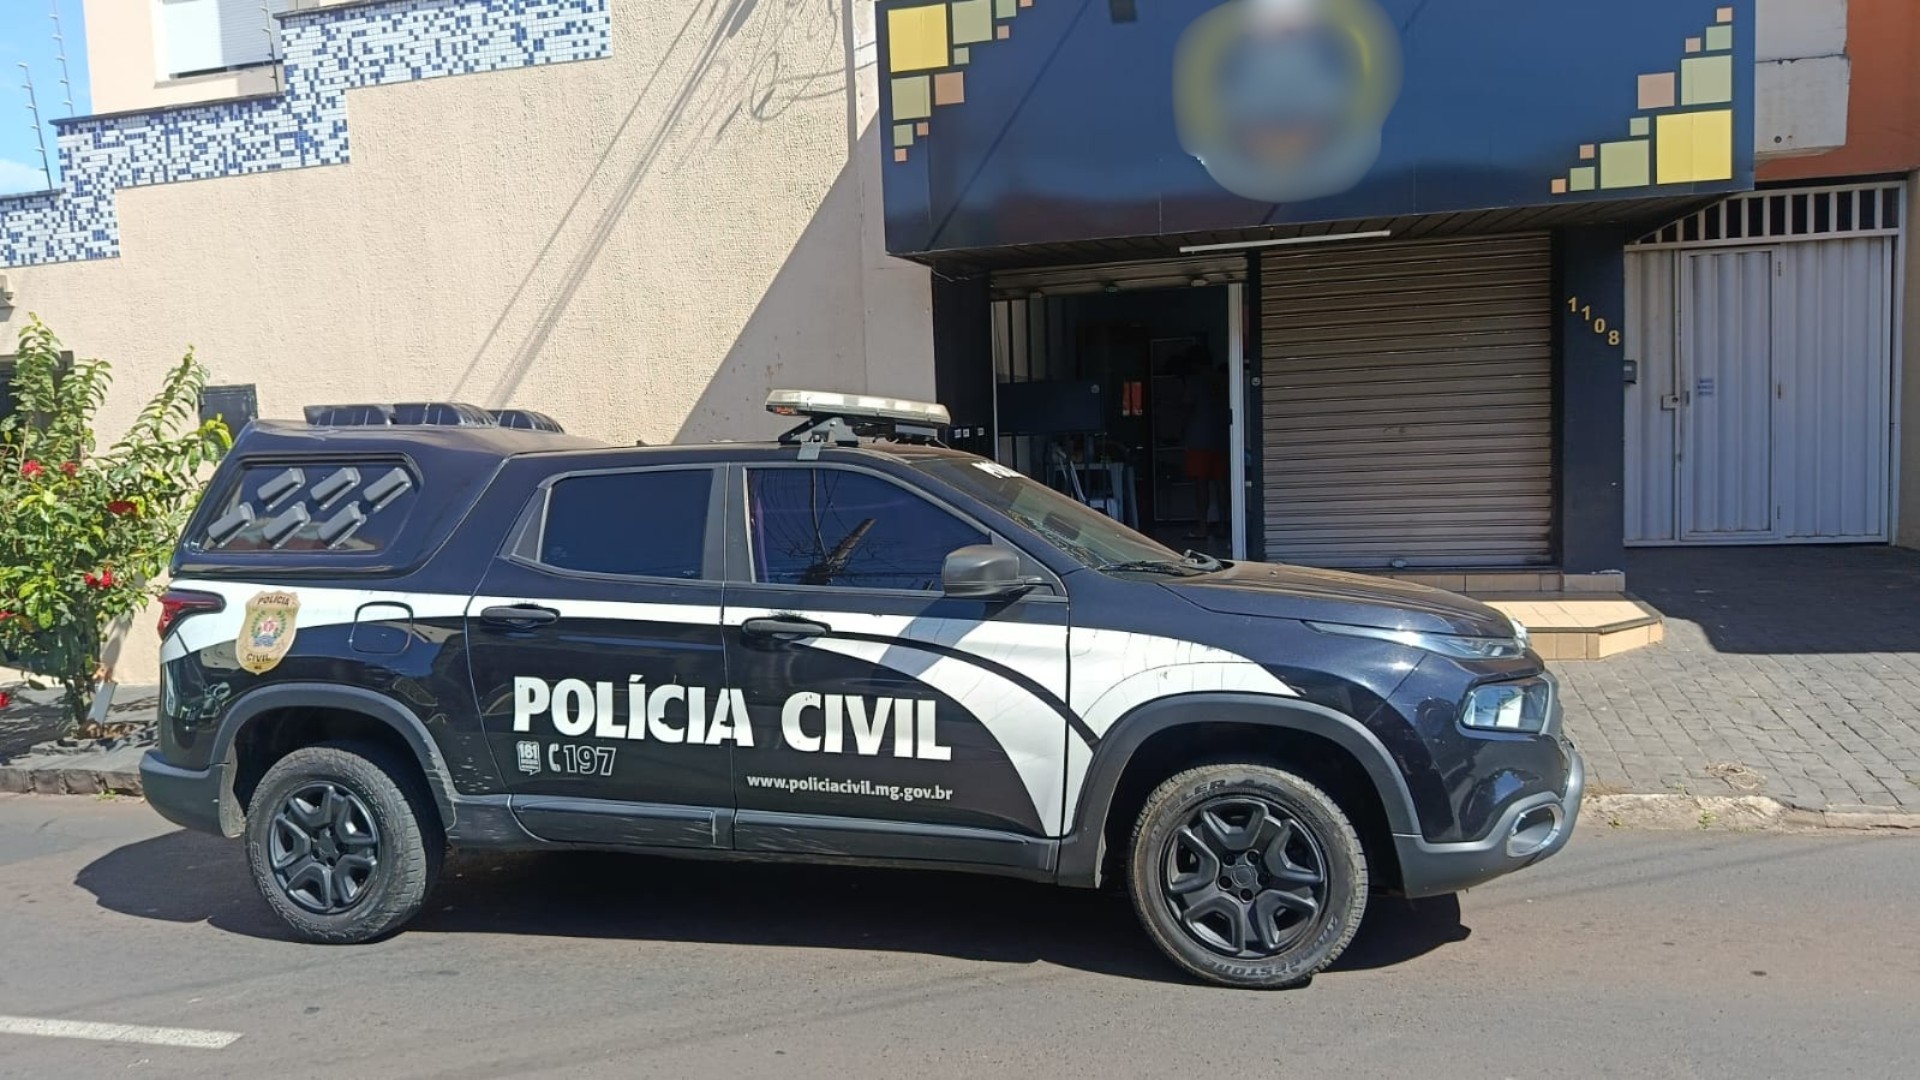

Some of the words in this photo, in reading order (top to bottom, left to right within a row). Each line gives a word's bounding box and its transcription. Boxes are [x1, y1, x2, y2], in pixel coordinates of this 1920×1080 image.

[1568, 297, 1620, 345] 1108
[246, 653, 272, 662] CIVIL
[513, 674, 754, 747] POLÍCIA
[781, 691, 952, 760] CIVIL
[519, 743, 539, 759] 181
[563, 744, 617, 776] 197
[747, 775, 953, 801] www.policiacivil.mg.gov.br
